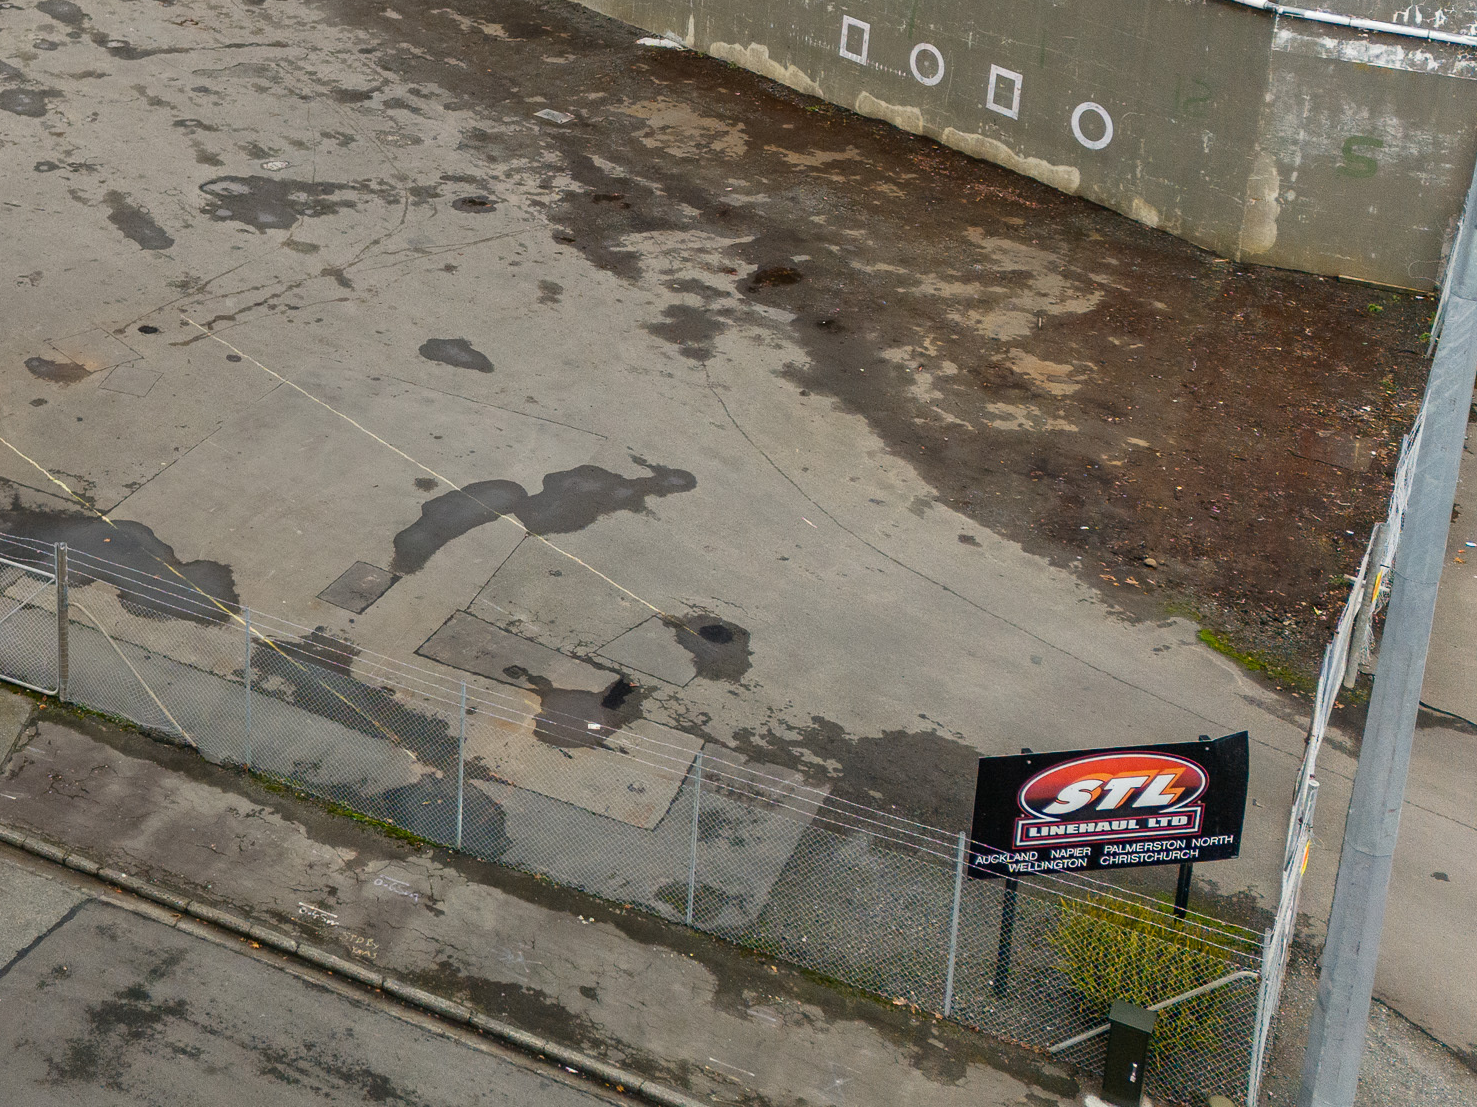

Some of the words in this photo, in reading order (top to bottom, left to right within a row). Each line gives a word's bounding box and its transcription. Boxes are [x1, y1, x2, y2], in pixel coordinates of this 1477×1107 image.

[1043, 769, 1185, 814] STL
[1028, 817, 1140, 838] LINEHAUL
[1147, 815, 1188, 828] LTD
[974, 851, 1038, 866] AUCKLAND
[1050, 847, 1092, 859] NAPIER
[1103, 840, 1187, 855] PALMERSTON
[1191, 835, 1234, 848] NORTH
[1008, 858, 1088, 873] WELLINGTON
[1099, 848, 1200, 866] CHRISTCHURCH
